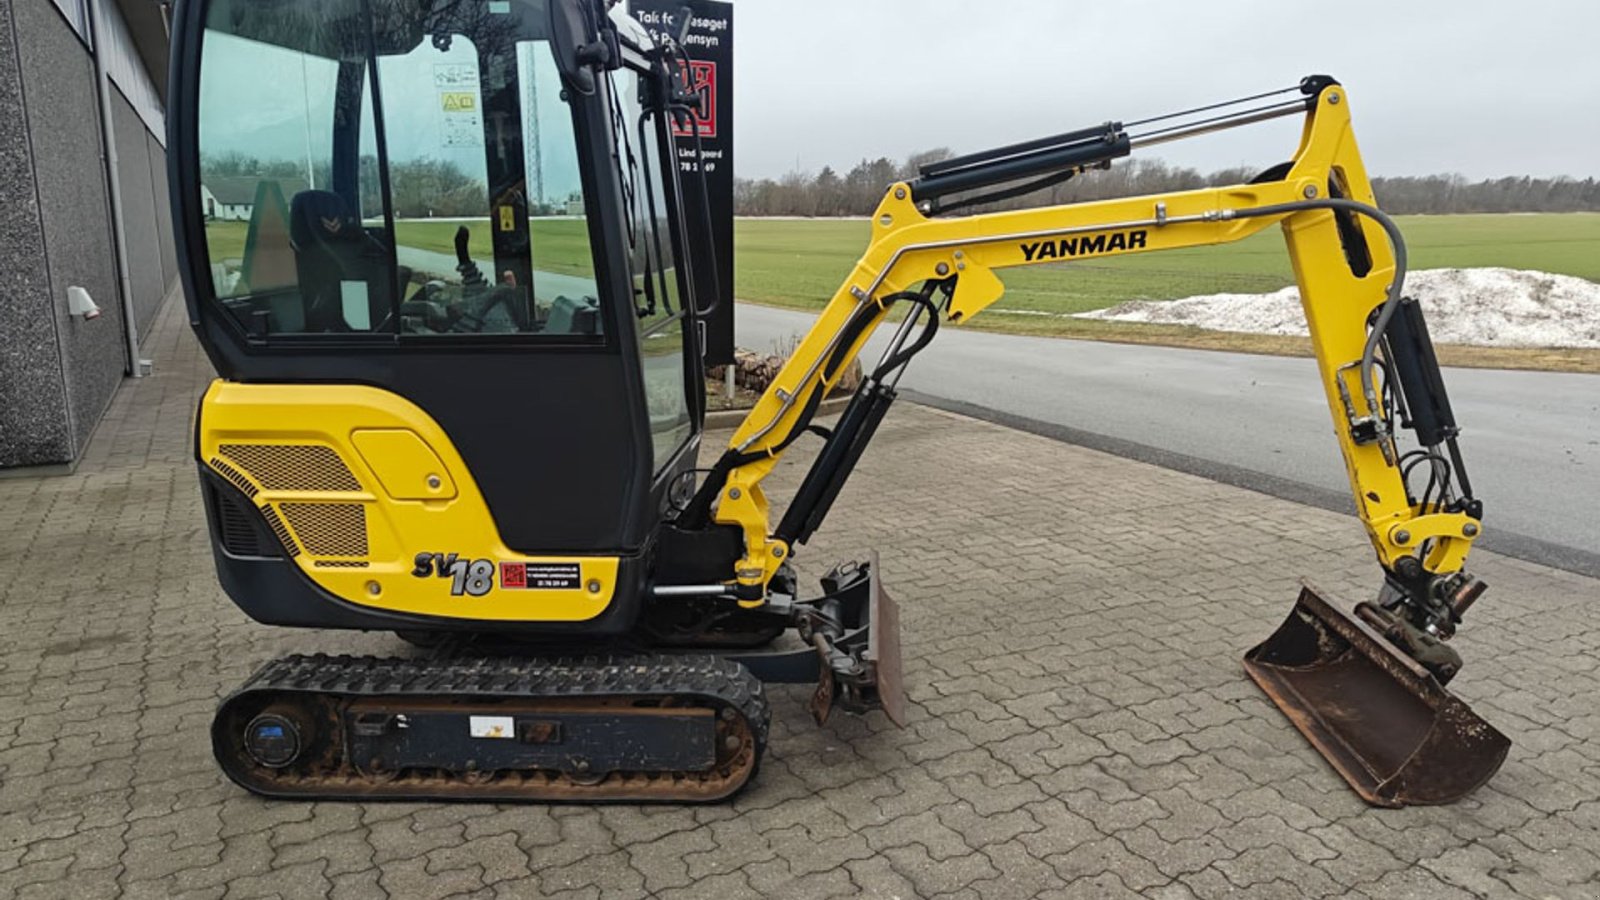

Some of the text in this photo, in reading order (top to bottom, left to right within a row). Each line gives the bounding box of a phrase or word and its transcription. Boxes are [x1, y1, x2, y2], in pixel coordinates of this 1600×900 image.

[690, 17, 728, 31] esøget
[683, 34, 719, 48] ensyn
[1020, 230, 1147, 261] YANMAR
[450, 558, 495, 597] 18
